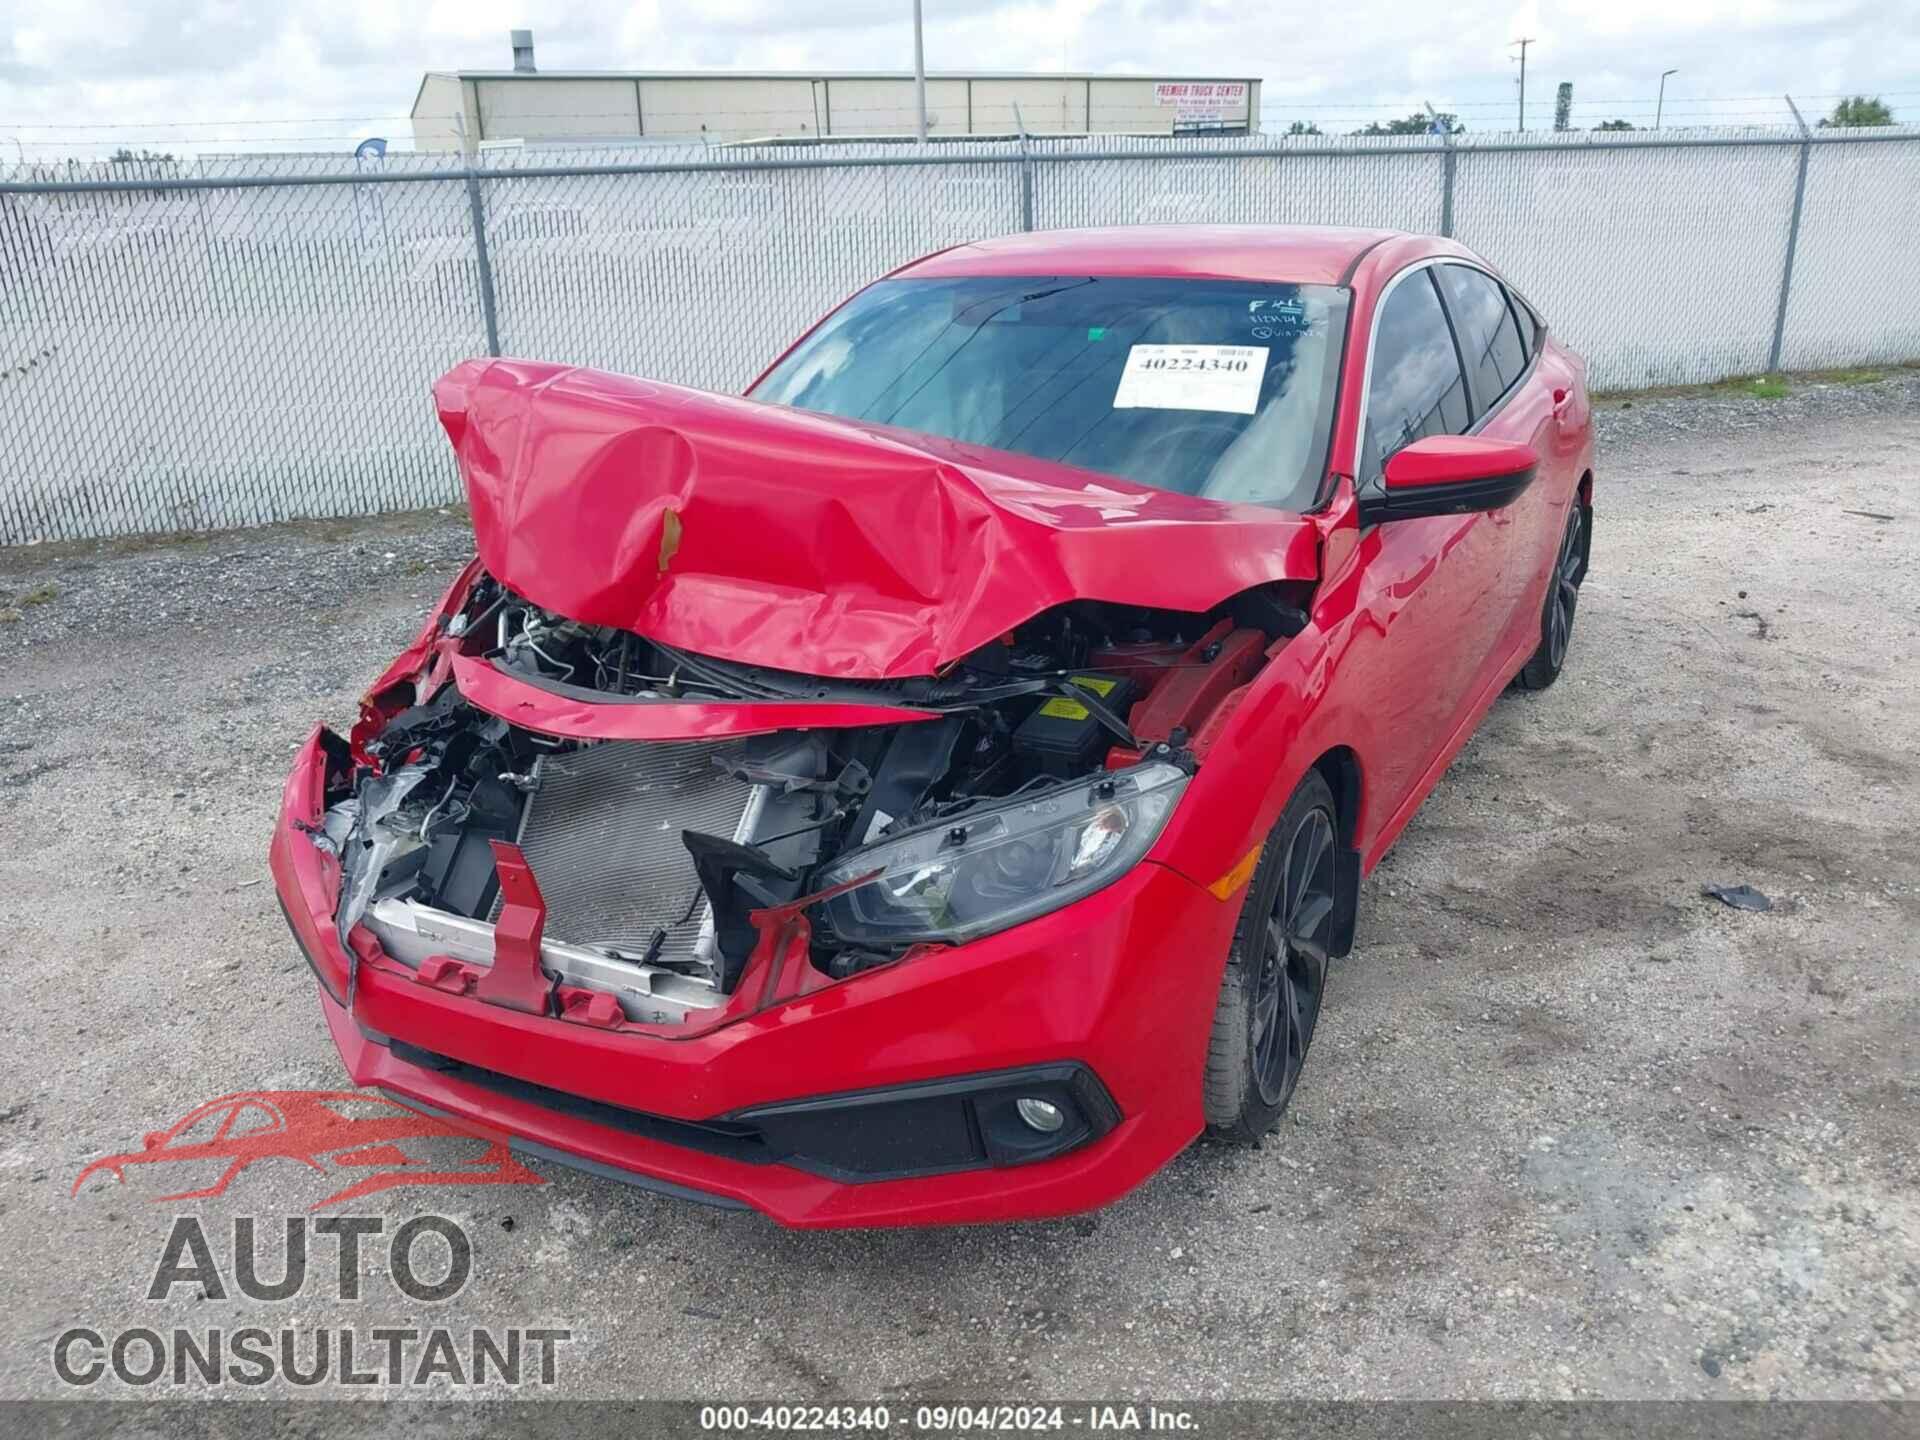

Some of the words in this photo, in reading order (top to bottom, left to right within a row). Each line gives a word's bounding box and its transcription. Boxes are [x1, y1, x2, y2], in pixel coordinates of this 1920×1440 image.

[1157, 85, 1189, 96] PREMIER
[1190, 85, 1214, 96] TRUCK
[1216, 85, 1245, 96] CENTER
[1139, 357, 1248, 372] 40224340
